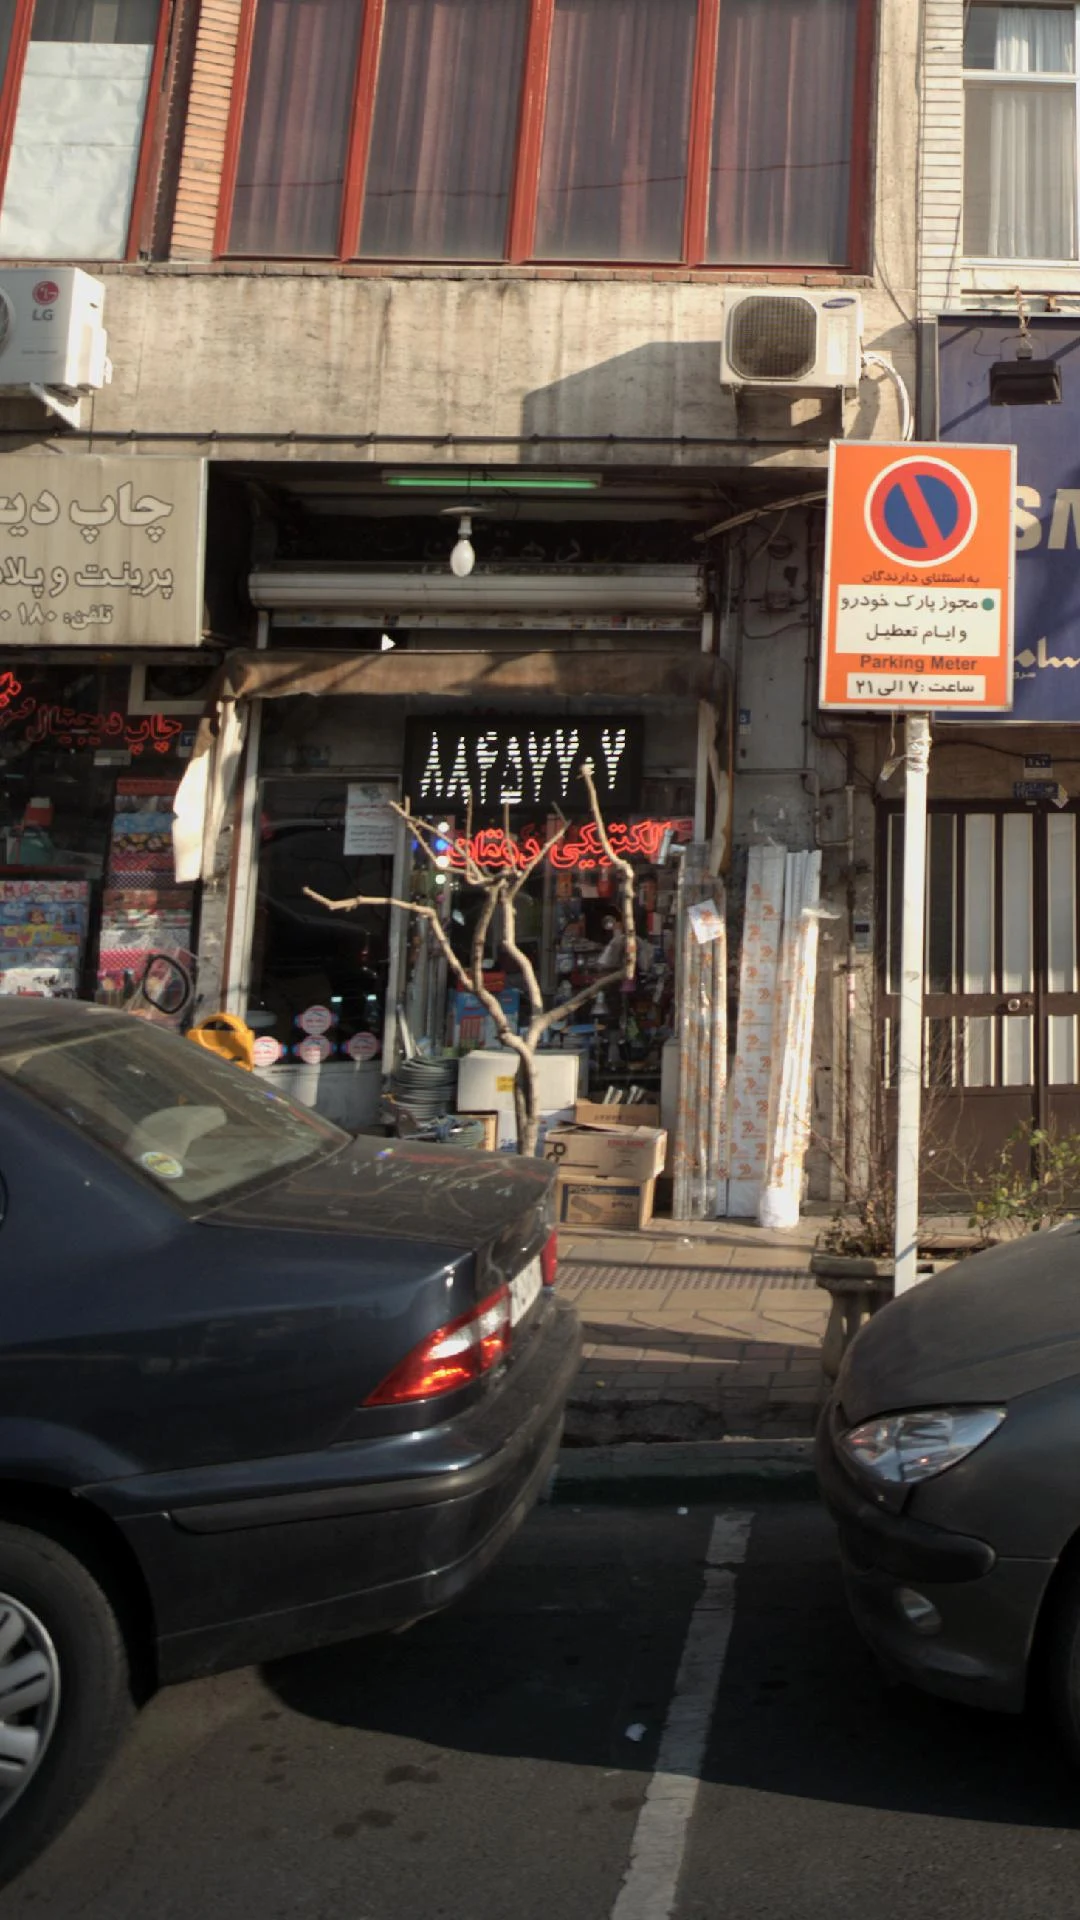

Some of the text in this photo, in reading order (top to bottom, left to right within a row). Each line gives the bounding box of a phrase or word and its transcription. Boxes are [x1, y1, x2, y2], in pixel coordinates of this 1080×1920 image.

[32, 309, 54, 321] LG
[68, 481, 174, 544] چاپ
[0, 556, 174, 600] پرینت و پلا
[862, 570, 980, 586] به استثنای دارندگان
[840, 593, 978, 613] مجوز پارک خودرو
[866, 623, 919, 642] تعطیل
[922, 625, 956, 645] ایام
[860, 655, 978, 672] Parking Meter
[856, 679, 874, 694] ۲۱
[877, 680, 903, 696] الی
[25, 704, 124, 745] دیجیتال
[124, 712, 183, 756] چاپ
